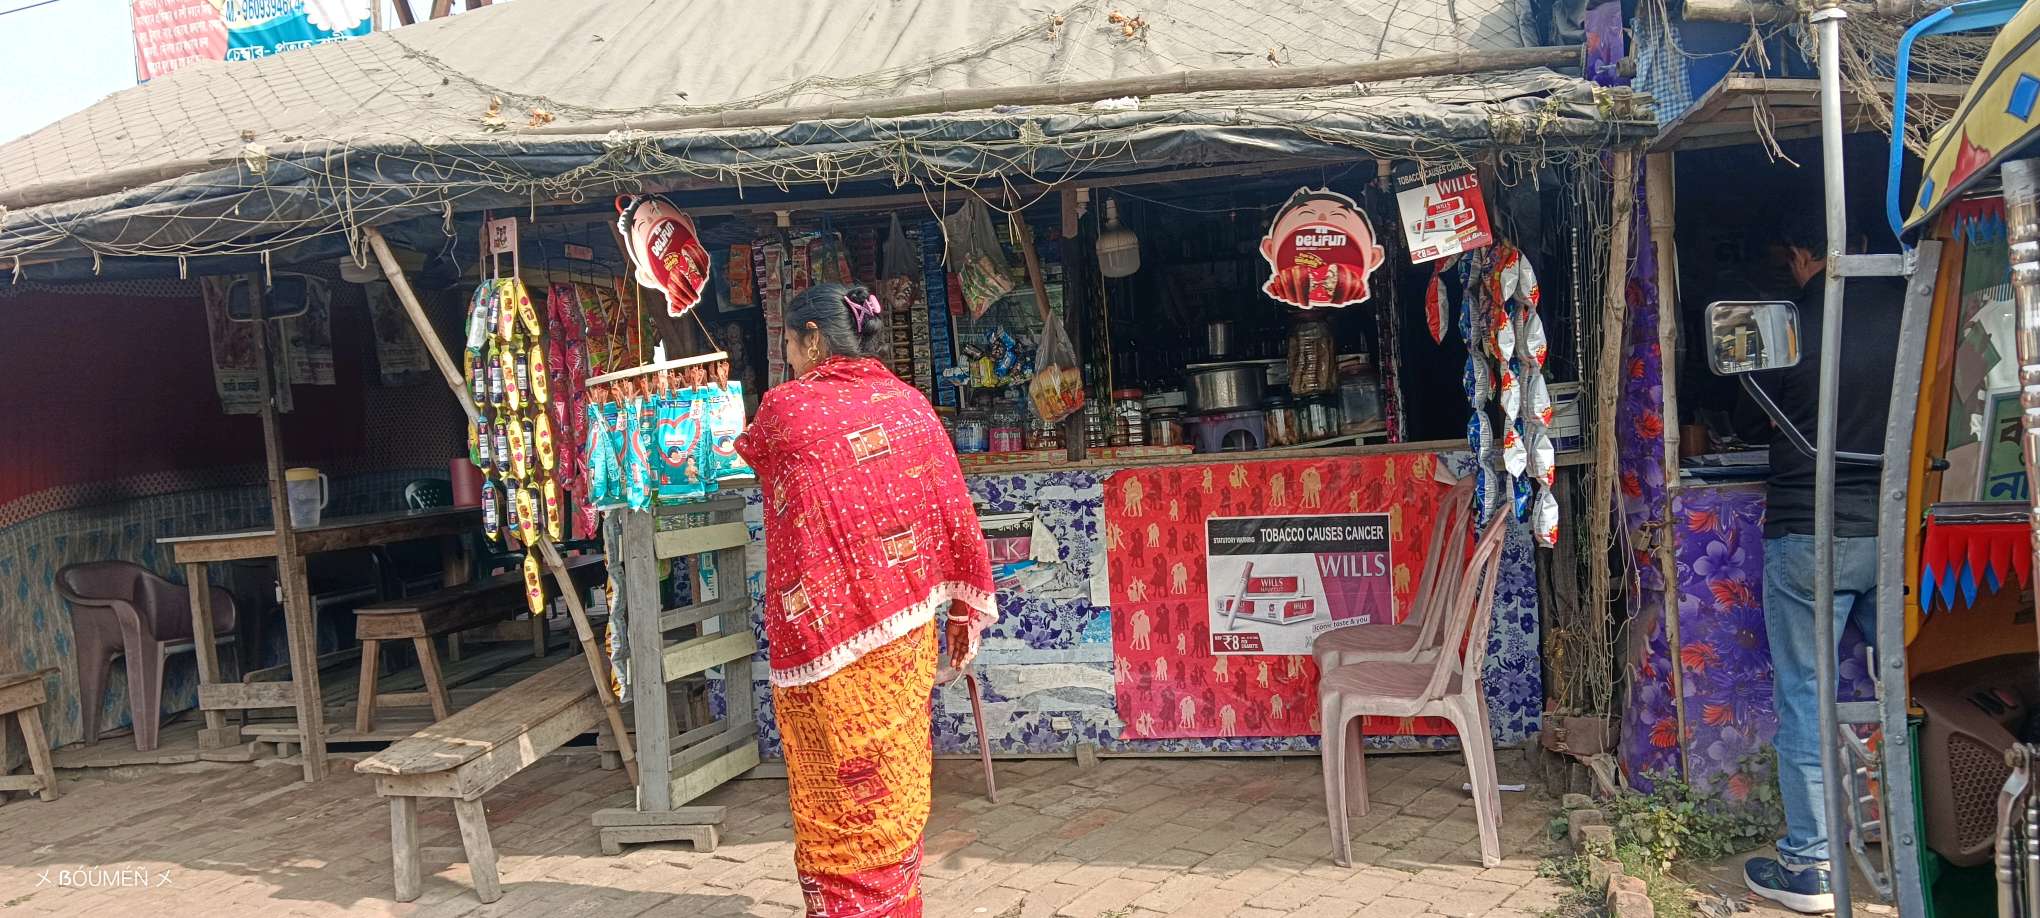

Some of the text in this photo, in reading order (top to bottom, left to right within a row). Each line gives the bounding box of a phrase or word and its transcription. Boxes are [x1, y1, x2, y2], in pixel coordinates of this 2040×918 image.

[1447, 159, 1472, 175] CANCE
[1438, 173, 1478, 195] WILLS
[1260, 527, 1305, 543] TOBACCO
[1306, 526, 1343, 541] CAUSES
[1345, 525, 1384, 540] CANCER
[1319, 553, 1386, 577] WILLS
[1261, 578, 1284, 587] WILLS
[1333, 620, 1349, 628] taste
[1355, 616, 1368, 625] you
